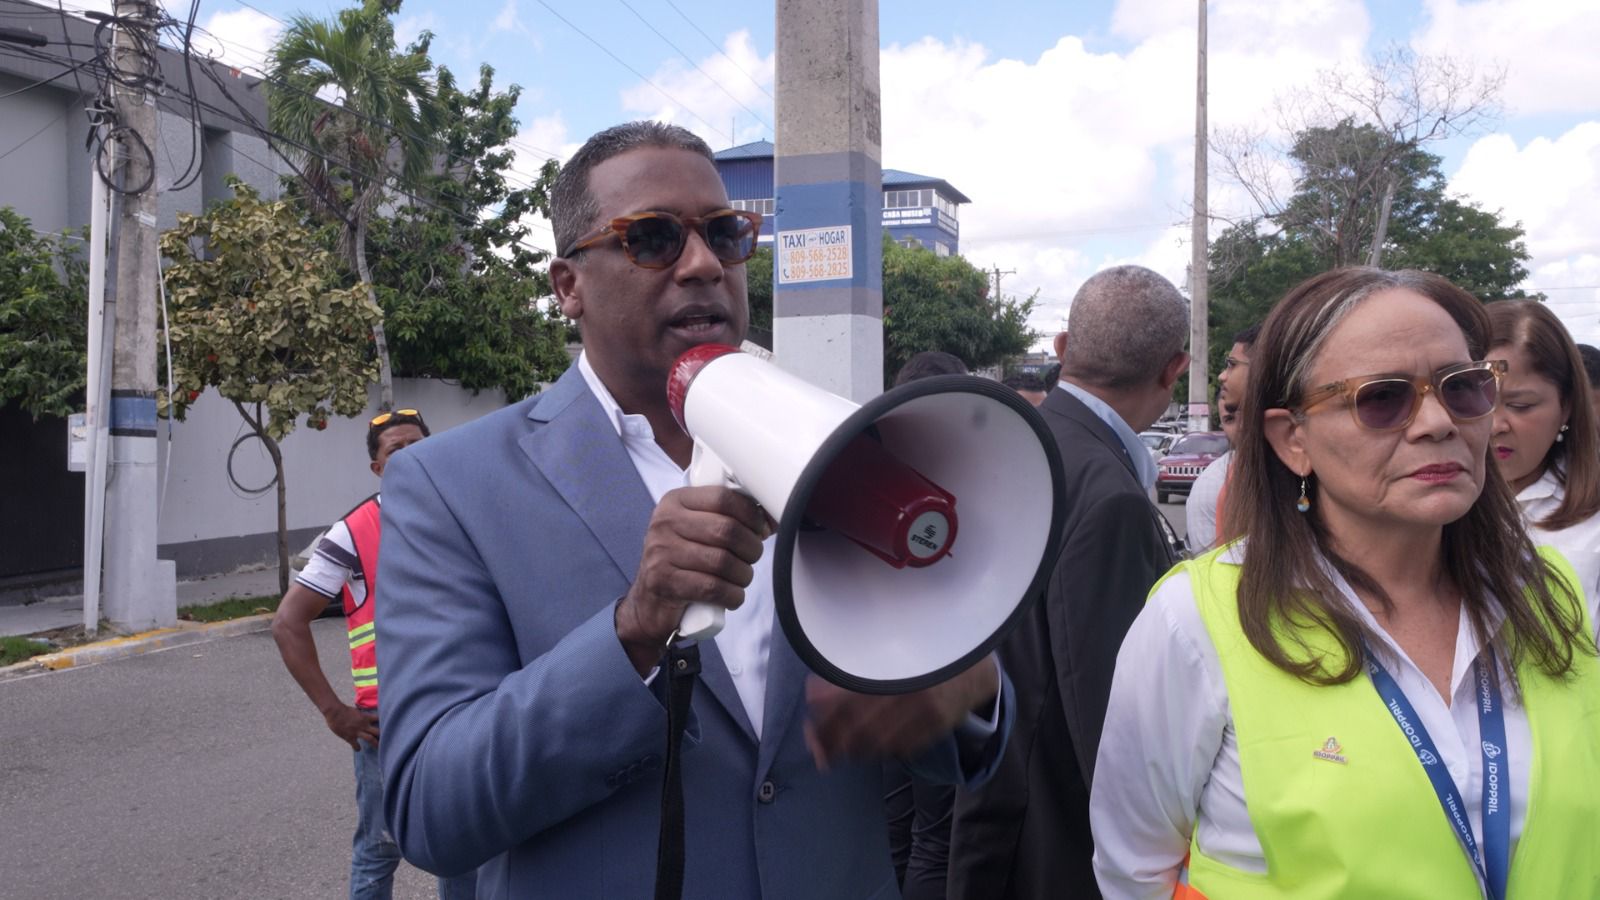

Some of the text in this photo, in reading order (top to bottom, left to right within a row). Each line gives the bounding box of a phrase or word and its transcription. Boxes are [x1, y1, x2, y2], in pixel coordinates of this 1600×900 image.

[783, 233, 806, 249] TAXI
[819, 230, 846, 246] HOGAR
[790, 246, 848, 265] 809-568-2528
[790, 261, 848, 279] 809-568-2825
[911, 534, 938, 551] STEREN
[1480, 667, 1493, 715] IDOPPRIL
[1389, 698, 1422, 748] IDOPPRIL
[1488, 762, 1499, 816] IDOPPRIL
[1446, 793, 1474, 847] IDOPPRIL
